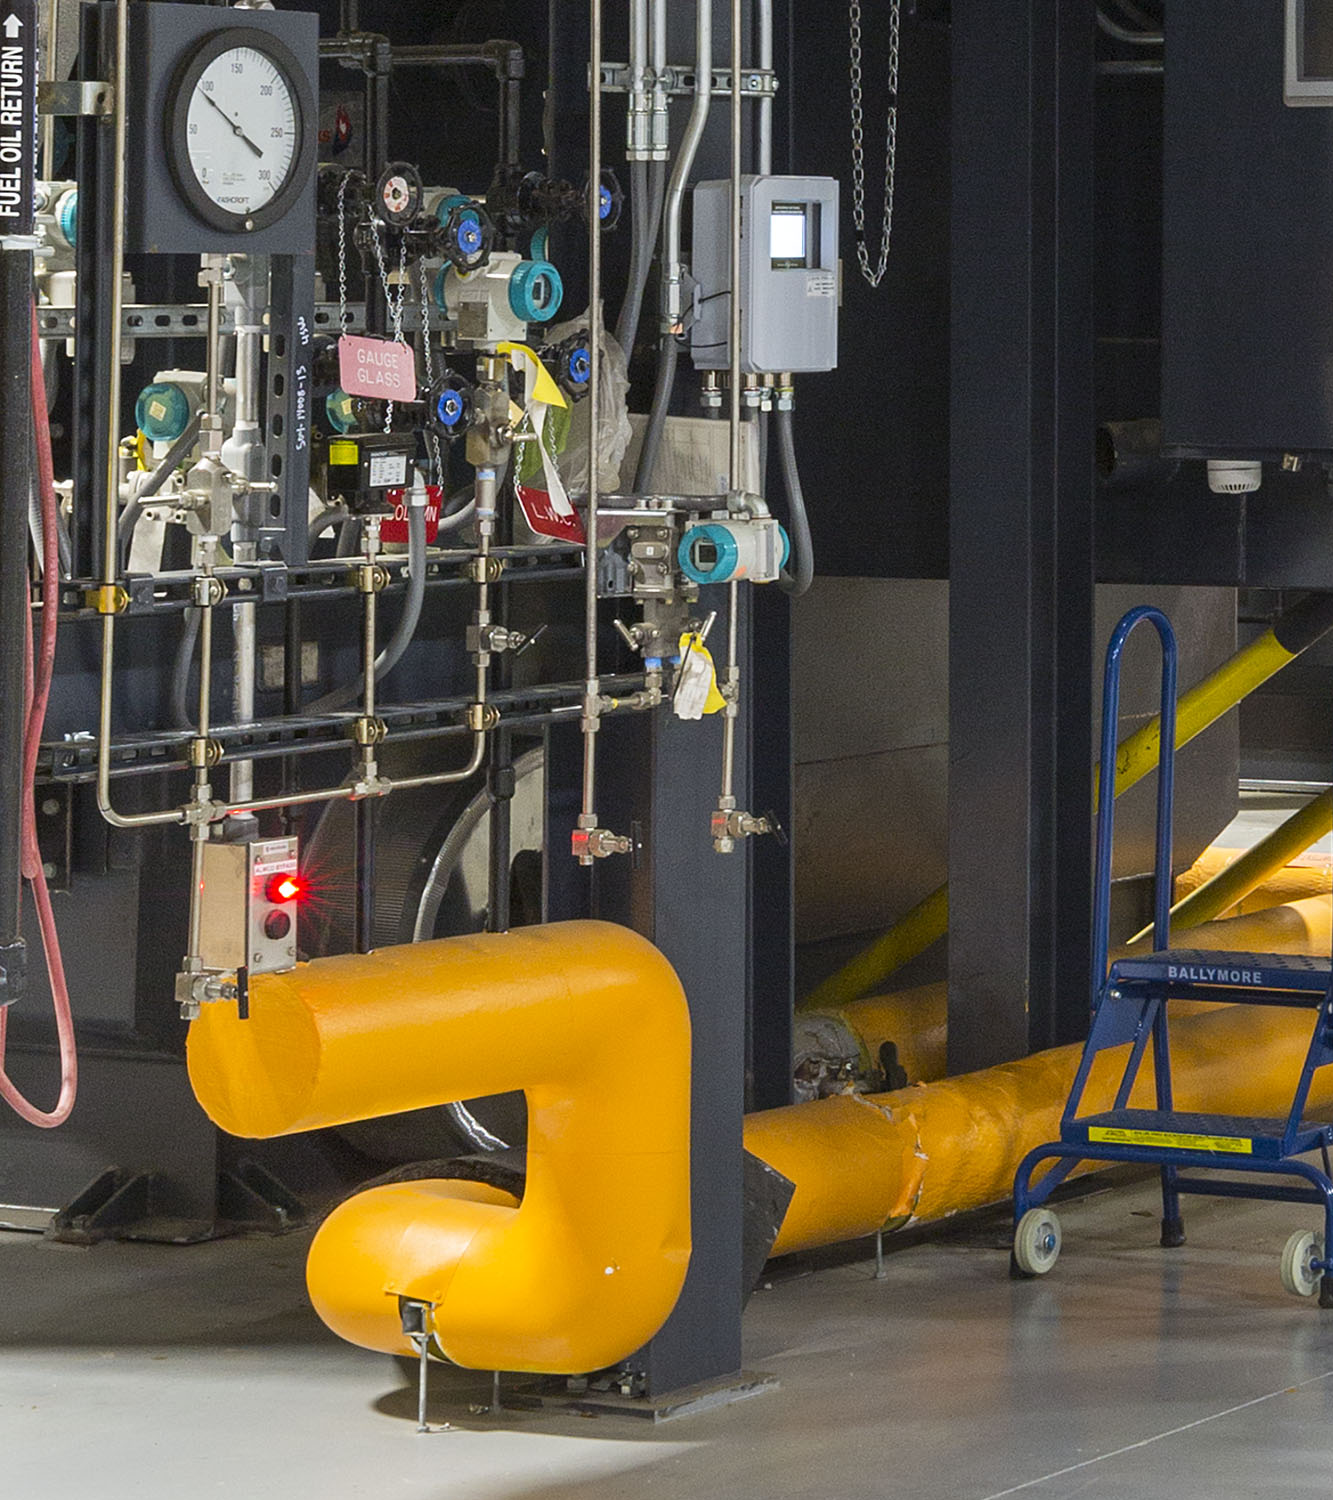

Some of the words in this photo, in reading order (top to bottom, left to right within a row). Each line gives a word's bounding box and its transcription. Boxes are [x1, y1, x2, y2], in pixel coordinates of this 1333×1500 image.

[230, 62, 243, 75] 150
[1, 46, 24, 110] RETURN
[201, 80, 214, 92] 100
[259, 84, 273, 96] 200
[0, 115, 23, 155] OIL
[189, 124, 198, 135] 50
[270, 127, 284, 138] 250
[258, 170, 271, 181] 300
[0, 157, 22, 218] FUEL
[357, 349, 399, 370] GAUGE
[357, 367, 401, 388] GLASS
[388, 504, 437, 522] OLMN
[1168, 964, 1263, 985] BALLYMORE
